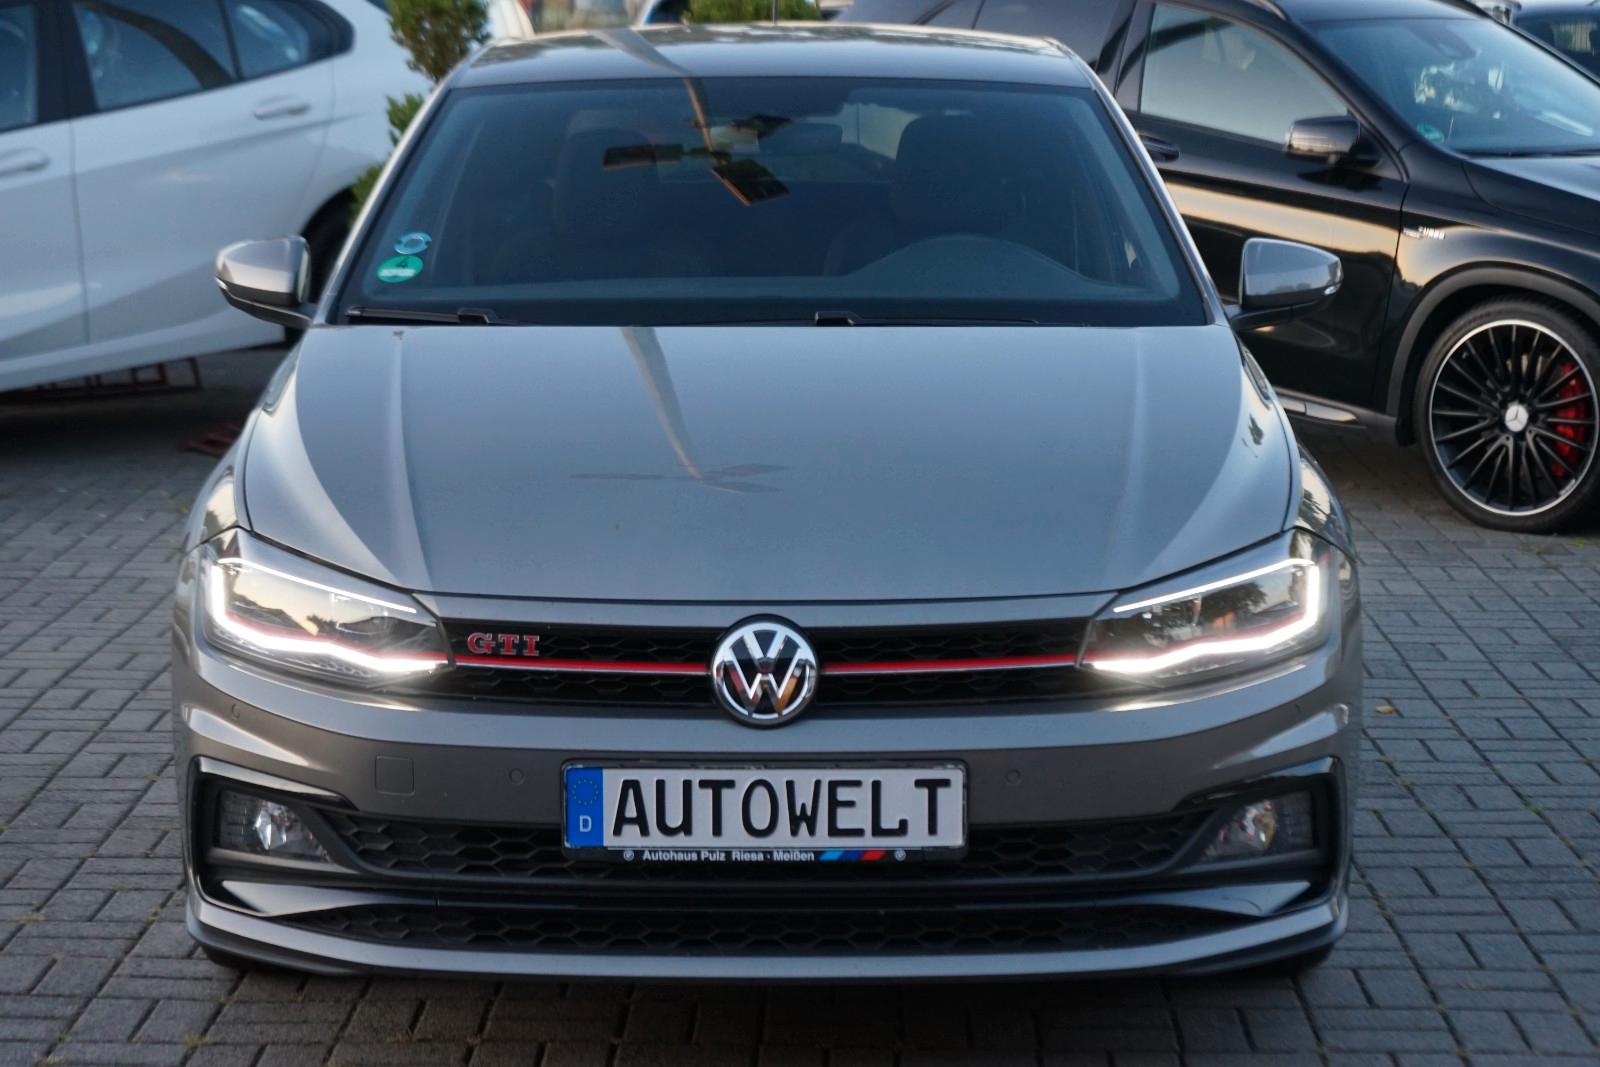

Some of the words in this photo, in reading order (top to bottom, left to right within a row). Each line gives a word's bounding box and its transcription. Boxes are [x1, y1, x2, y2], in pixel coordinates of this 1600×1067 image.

[467, 632, 539, 656] GTI
[612, 778, 952, 838] AUTOWELT
[579, 815, 592, 832] D
[642, 850, 698, 861] Autohaus
[700, 850, 726, 861] Pulz
[731, 850, 764, 861] Riesa
[773, 849, 814, 861] Meißen
